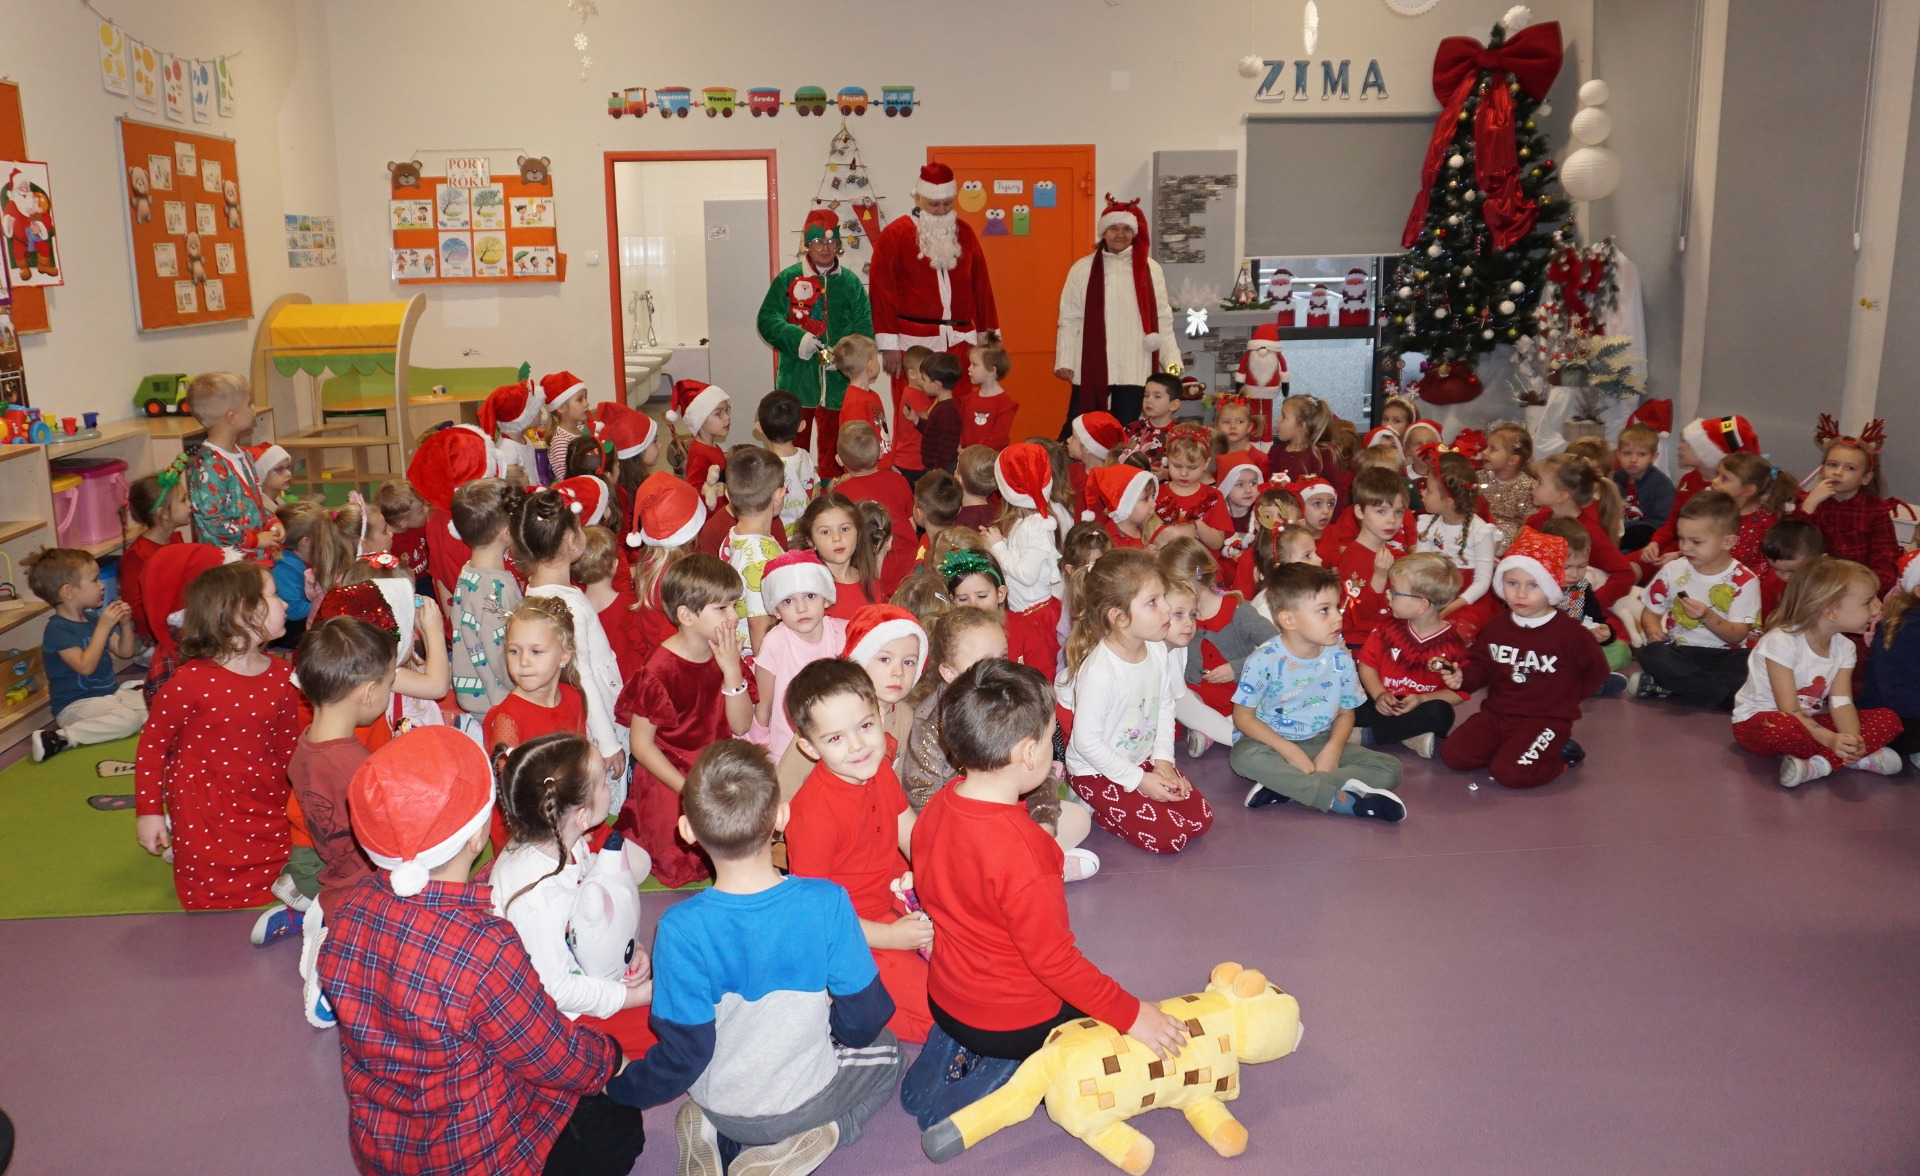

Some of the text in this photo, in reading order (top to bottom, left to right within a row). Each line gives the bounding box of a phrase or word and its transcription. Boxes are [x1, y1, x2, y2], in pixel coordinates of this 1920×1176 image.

[1255, 59, 1389, 101] ZIMA
[449, 159, 487, 169] PORY
[449, 177, 489, 187] ROKU
[1489, 643, 1558, 673] RELAX
[1517, 727, 1556, 765] RELAX
